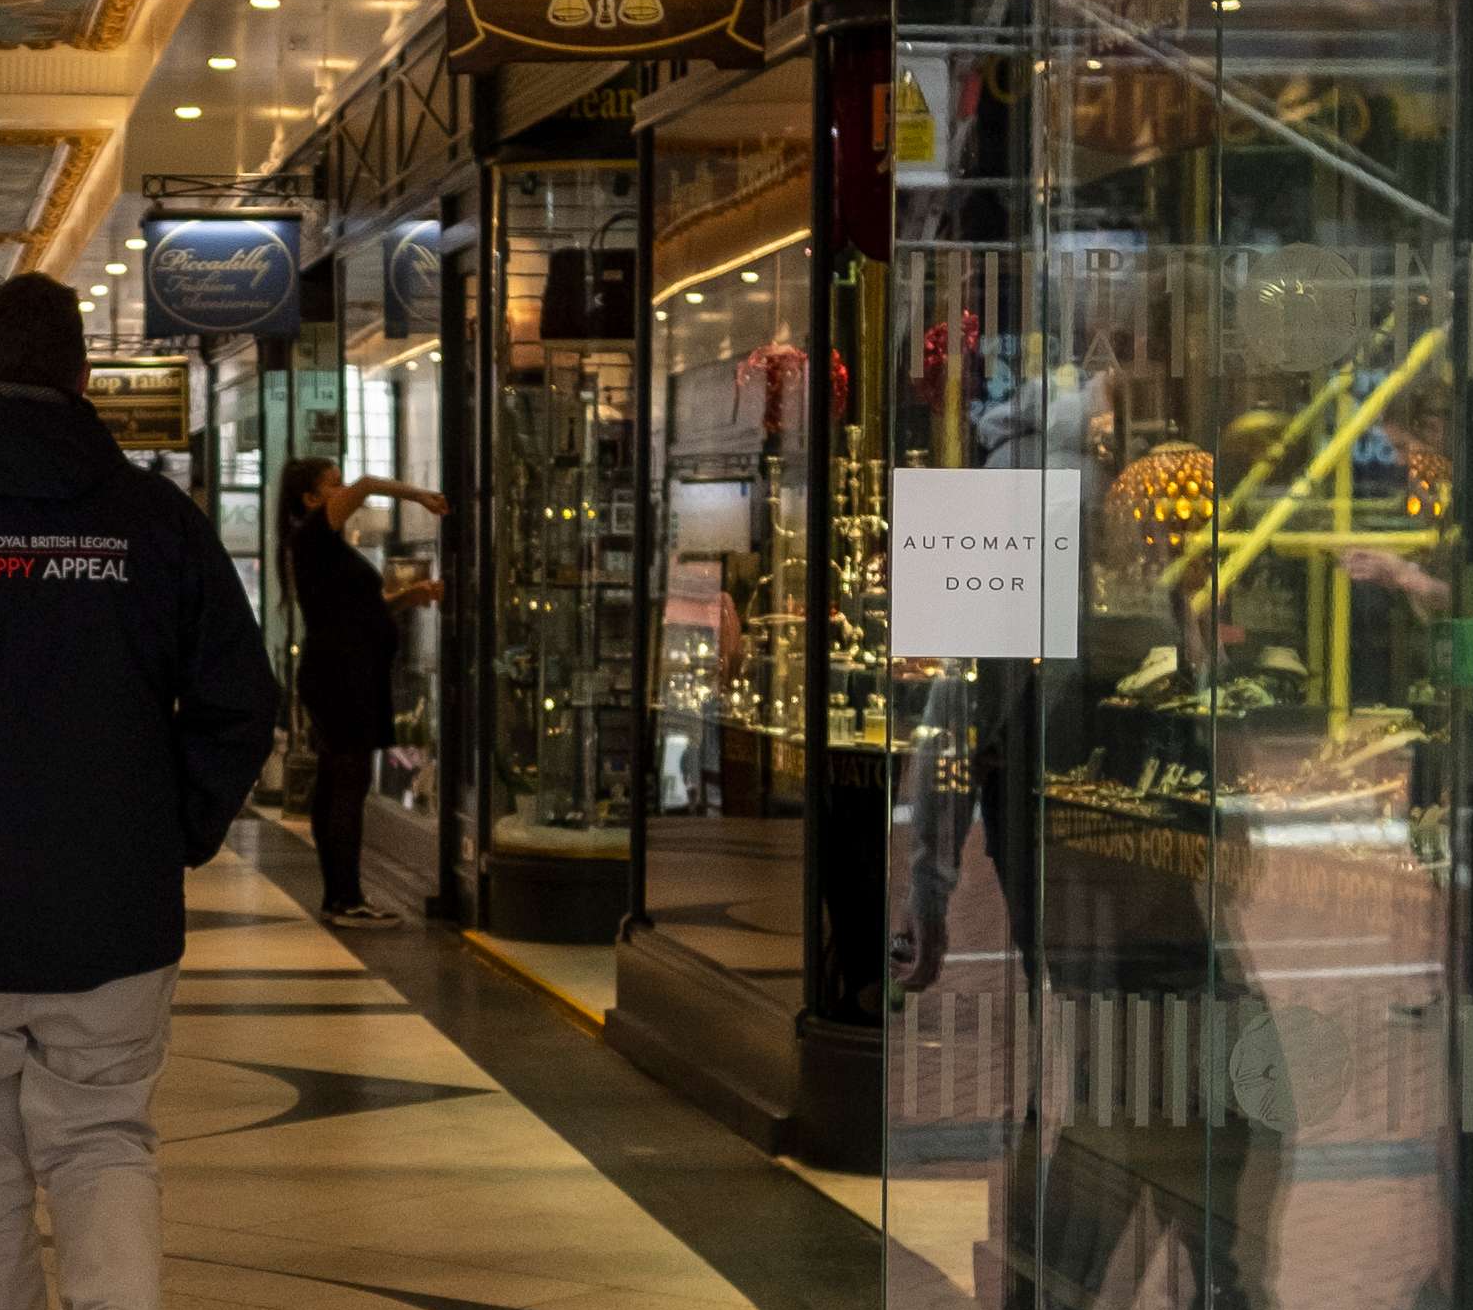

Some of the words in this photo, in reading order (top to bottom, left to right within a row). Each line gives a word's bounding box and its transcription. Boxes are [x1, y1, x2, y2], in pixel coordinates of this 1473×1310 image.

[156, 243, 278, 290] Piccadilly
[30, 536, 77, 548] BRITISH
[79, 536, 129, 550] LEGION
[903, 536, 1070, 551] AUTOMATC
[41, 557, 129, 582] APPEAL
[945, 577, 1026, 592] DOOR
